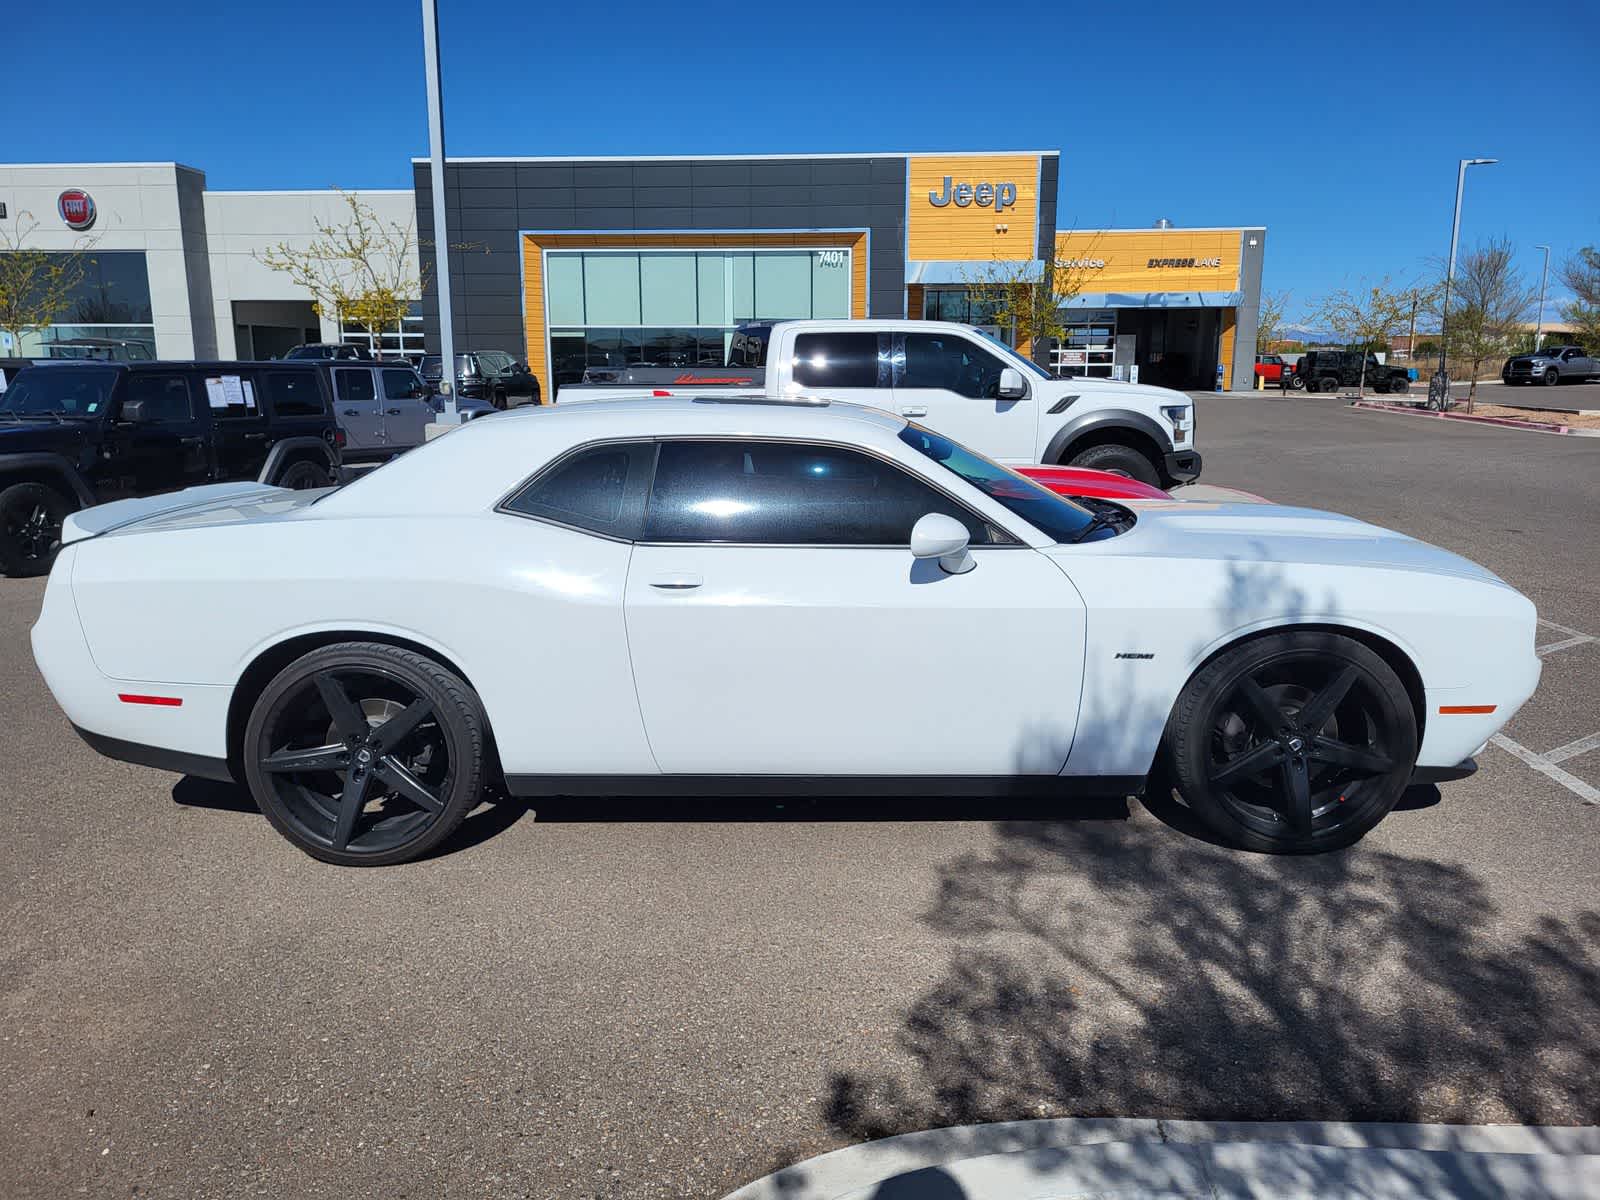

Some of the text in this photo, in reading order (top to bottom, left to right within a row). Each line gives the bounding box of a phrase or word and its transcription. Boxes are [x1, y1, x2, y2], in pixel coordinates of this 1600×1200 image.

[928, 175, 1017, 213] Jeep
[64, 200, 84, 214] FIAT
[818, 251, 843, 263] 7401
[1054, 257, 1105, 269] Service
